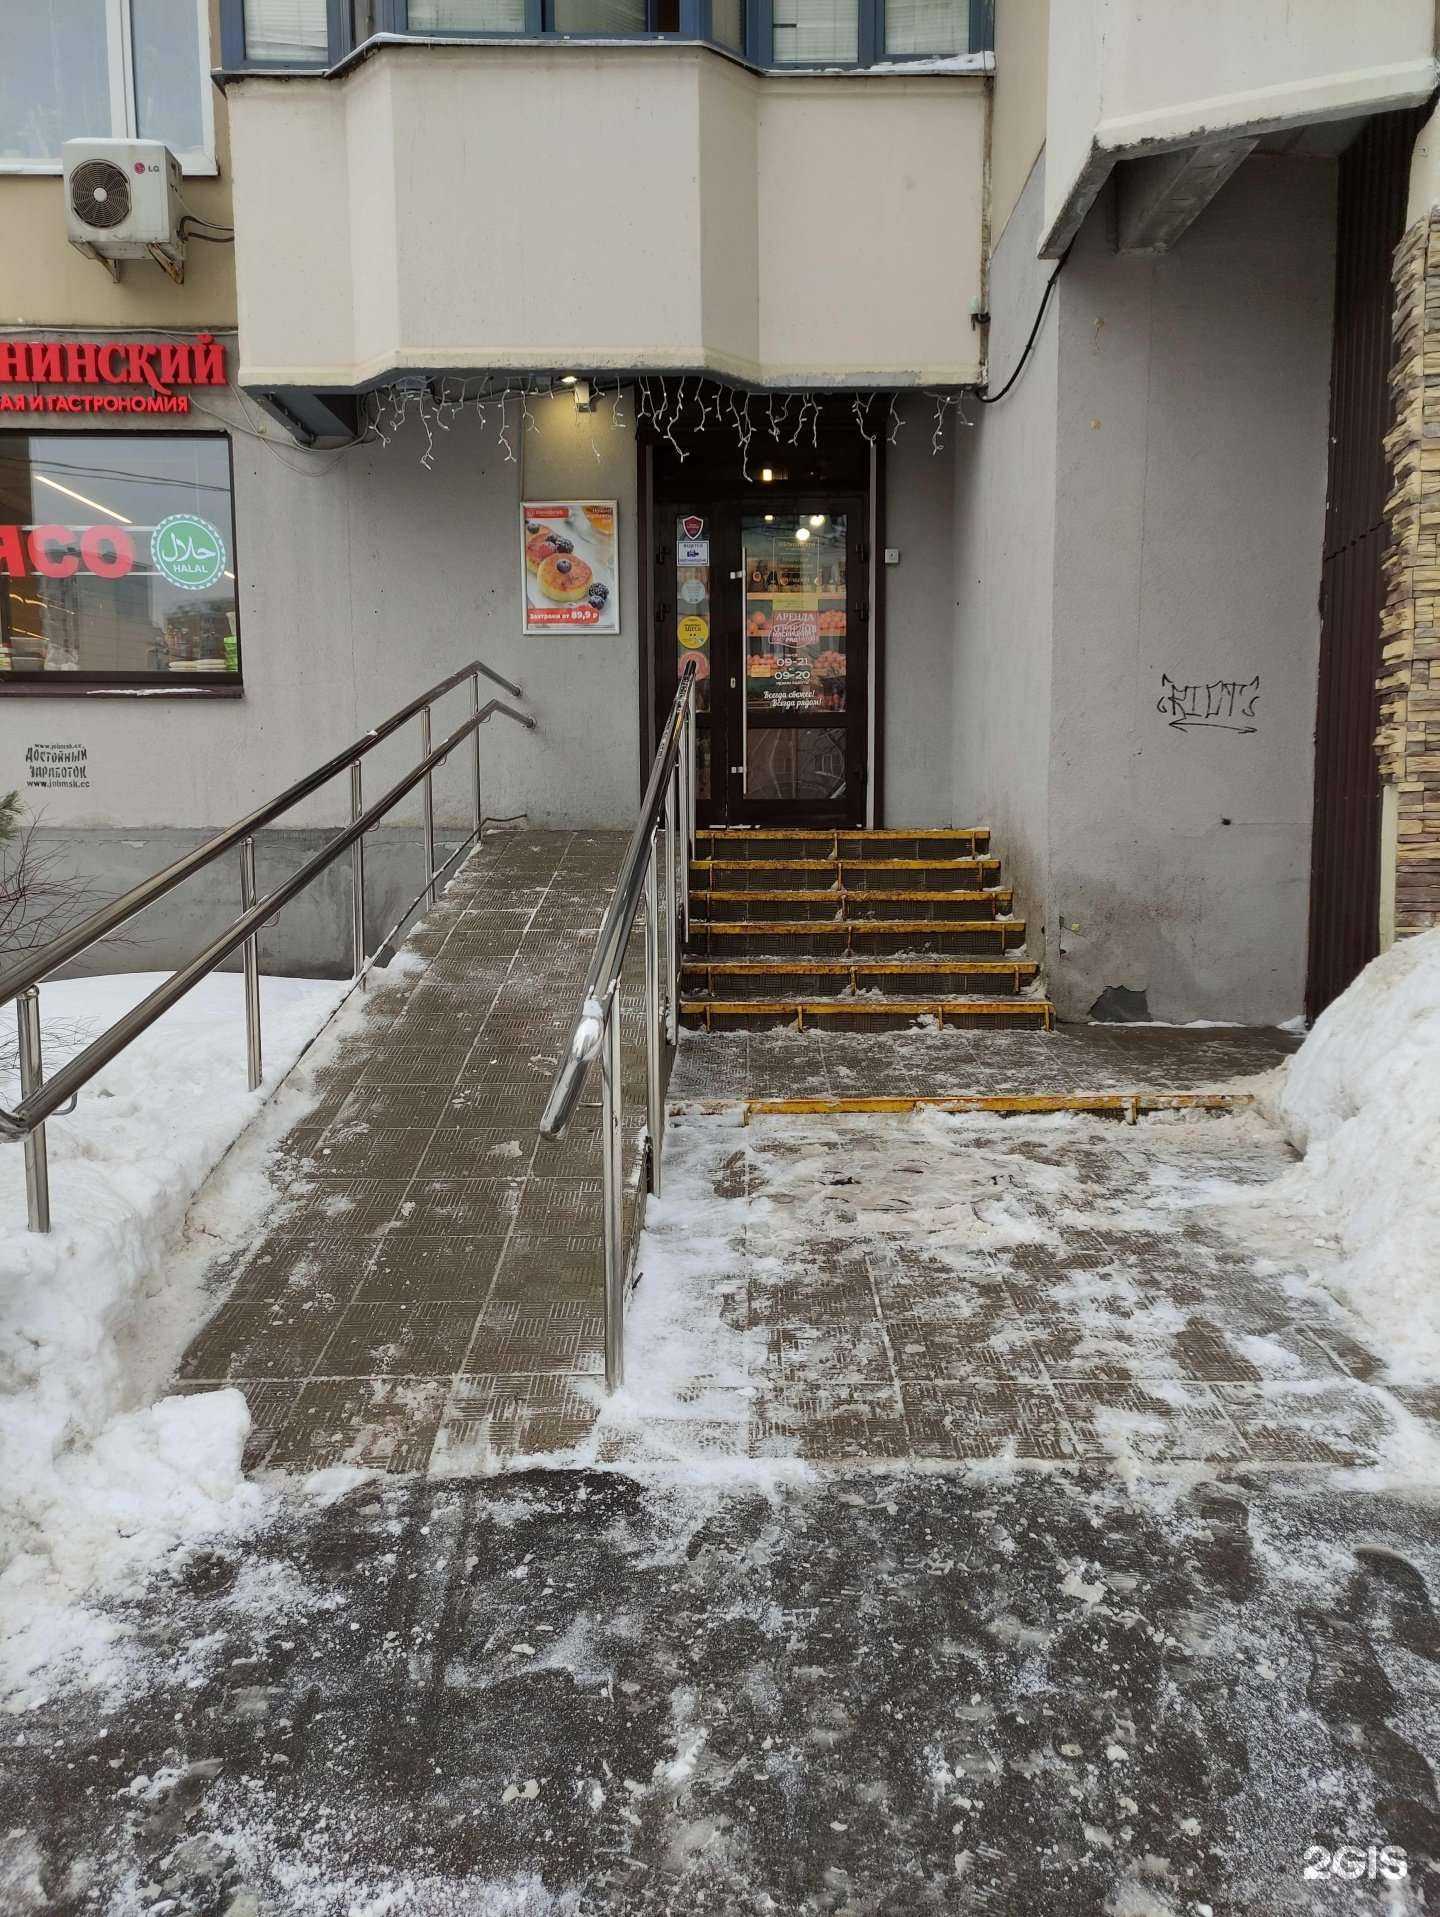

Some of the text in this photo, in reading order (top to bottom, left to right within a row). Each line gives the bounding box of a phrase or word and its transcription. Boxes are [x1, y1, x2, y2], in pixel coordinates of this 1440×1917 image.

[148, 164, 160, 173] LG
[0, 334, 228, 395] НИНСКИЙ
[29, 394, 44, 411] И
[47, 395, 189, 414] ГАСТРОНОМИЯ
[161, 532, 217, 562] حلال
[172, 562, 209, 574] HALAL
[776, 657, 809, 667] 09-21
[774, 670, 811, 680] 09-20
